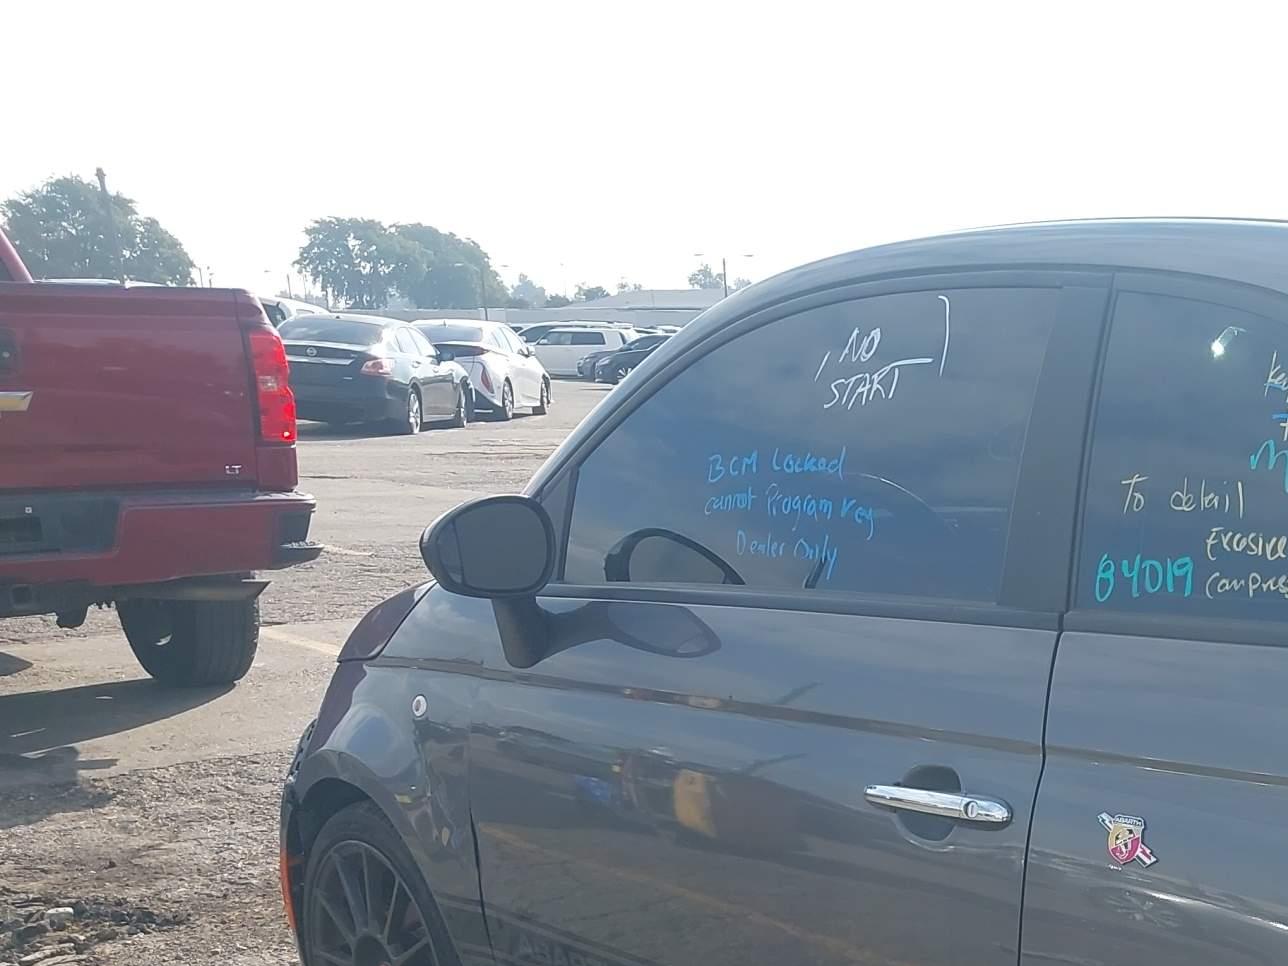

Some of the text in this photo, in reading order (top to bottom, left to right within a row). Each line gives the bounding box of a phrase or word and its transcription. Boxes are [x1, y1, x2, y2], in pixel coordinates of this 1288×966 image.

[838, 327, 881, 363] NO
[823, 358, 934, 410] START
[708, 450, 758, 483] BCM
[704, 486, 757, 516] cannot
[1121, 473, 1244, 519] To detail
[736, 530, 785, 558] Dealer
